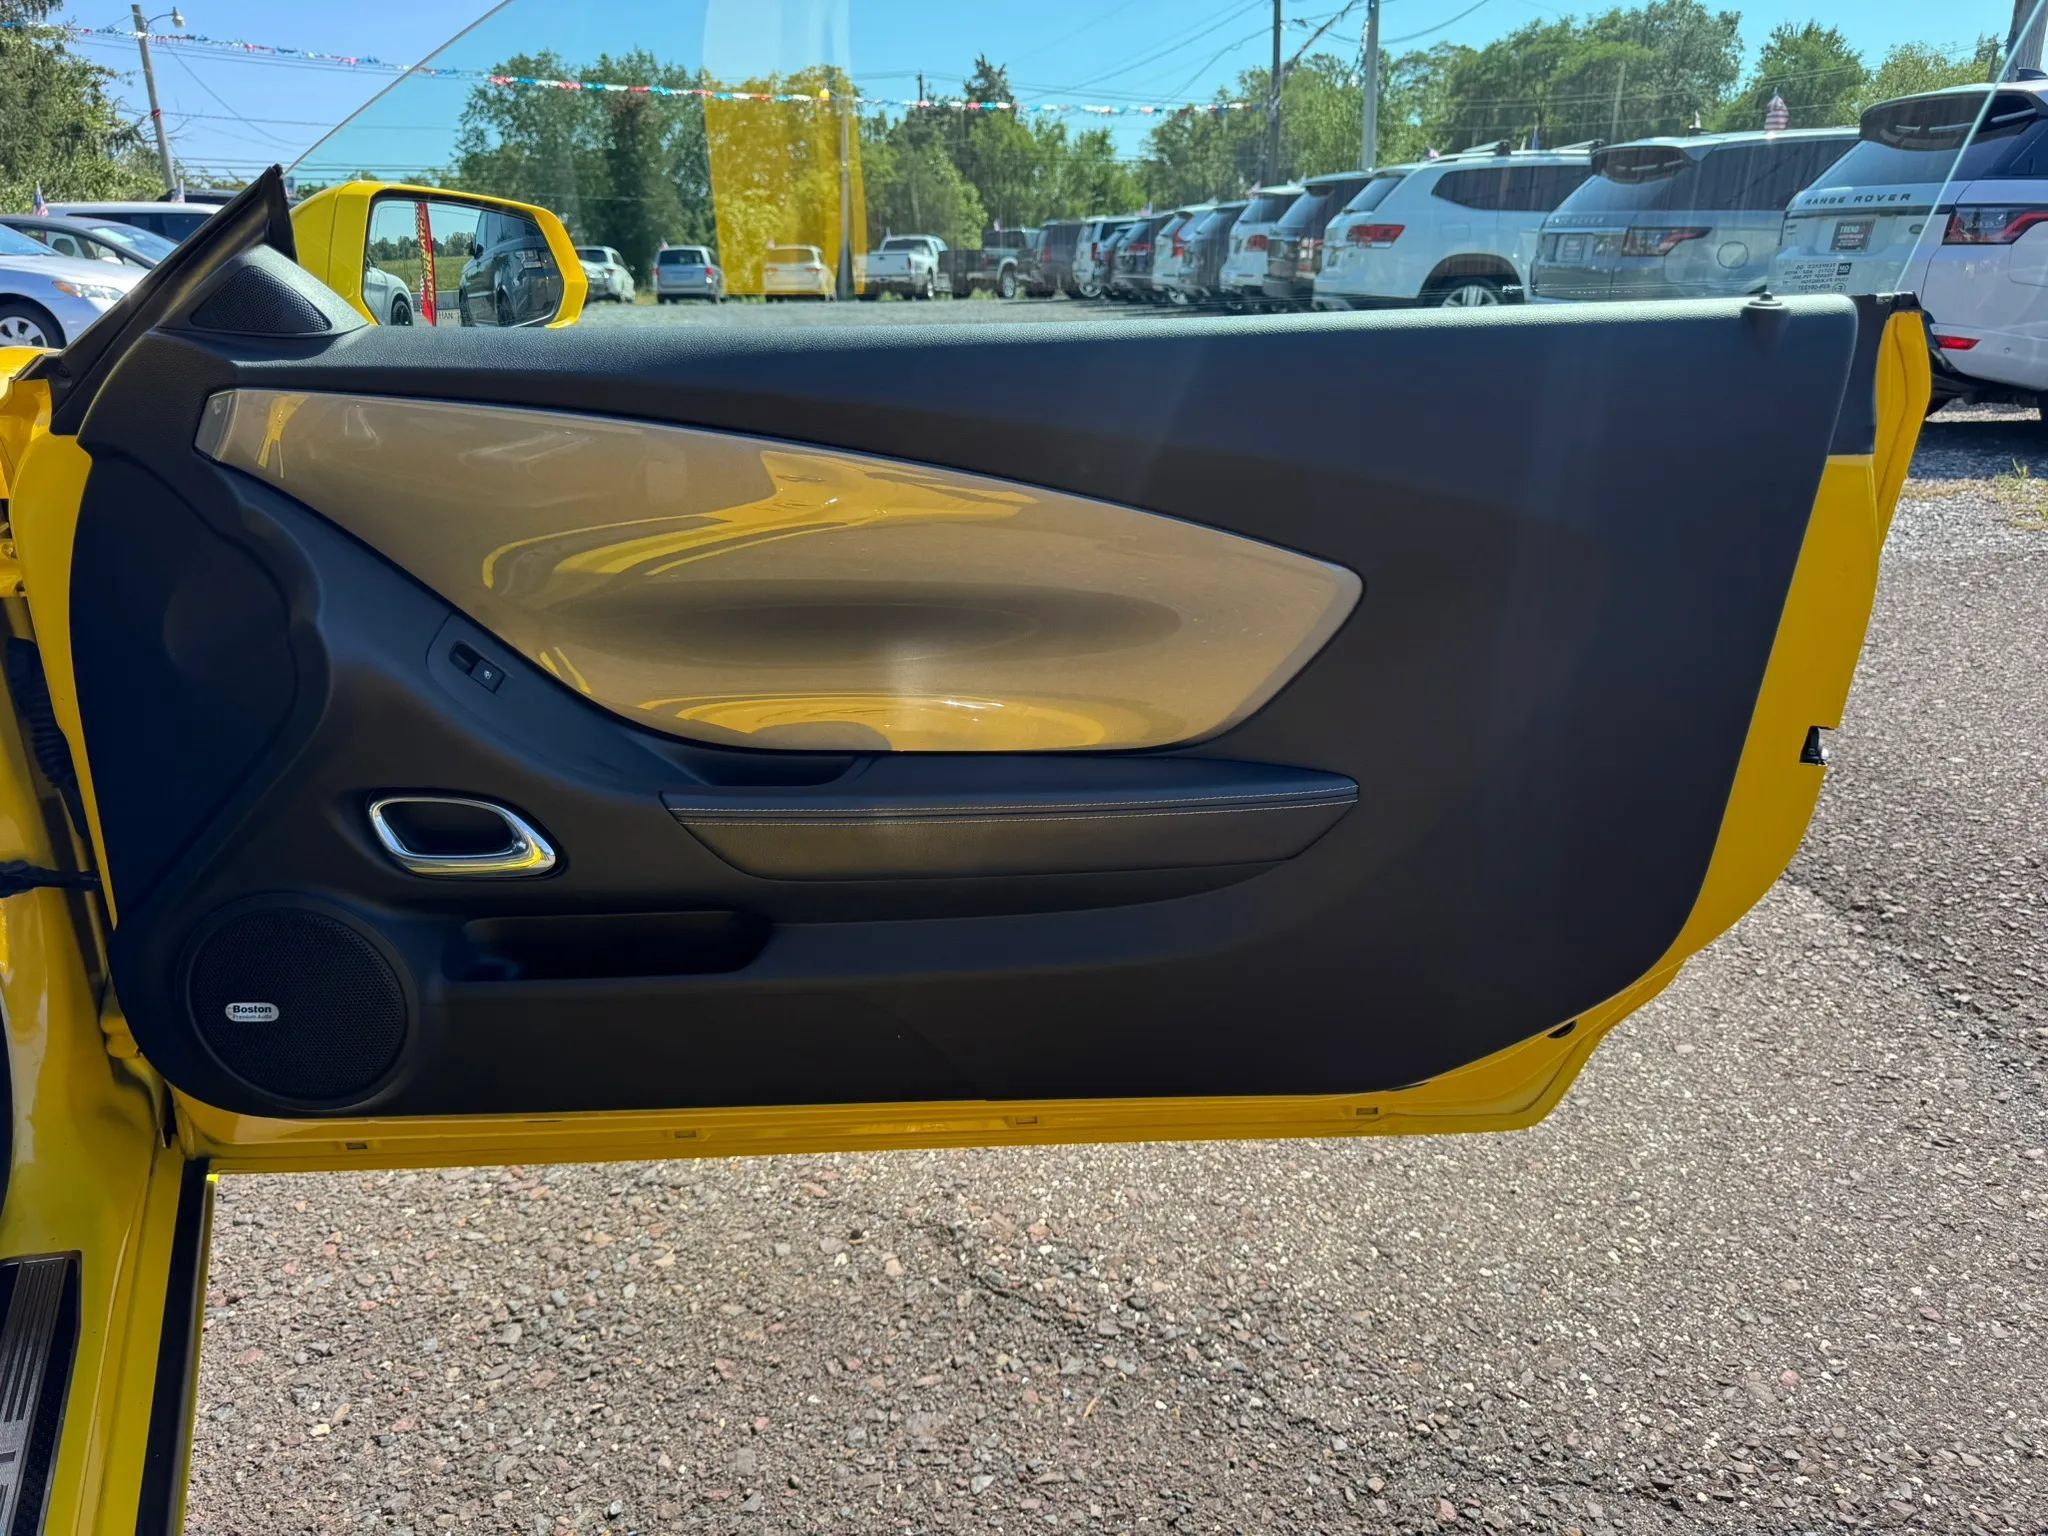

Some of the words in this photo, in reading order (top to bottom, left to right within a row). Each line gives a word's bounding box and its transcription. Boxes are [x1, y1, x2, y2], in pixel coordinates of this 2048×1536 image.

[1804, 196, 1846, 205] RANGE
[1854, 193, 1912, 203] ROVER
[437, 311, 453, 319] HAN
[233, 1005, 272, 1013] Boston
